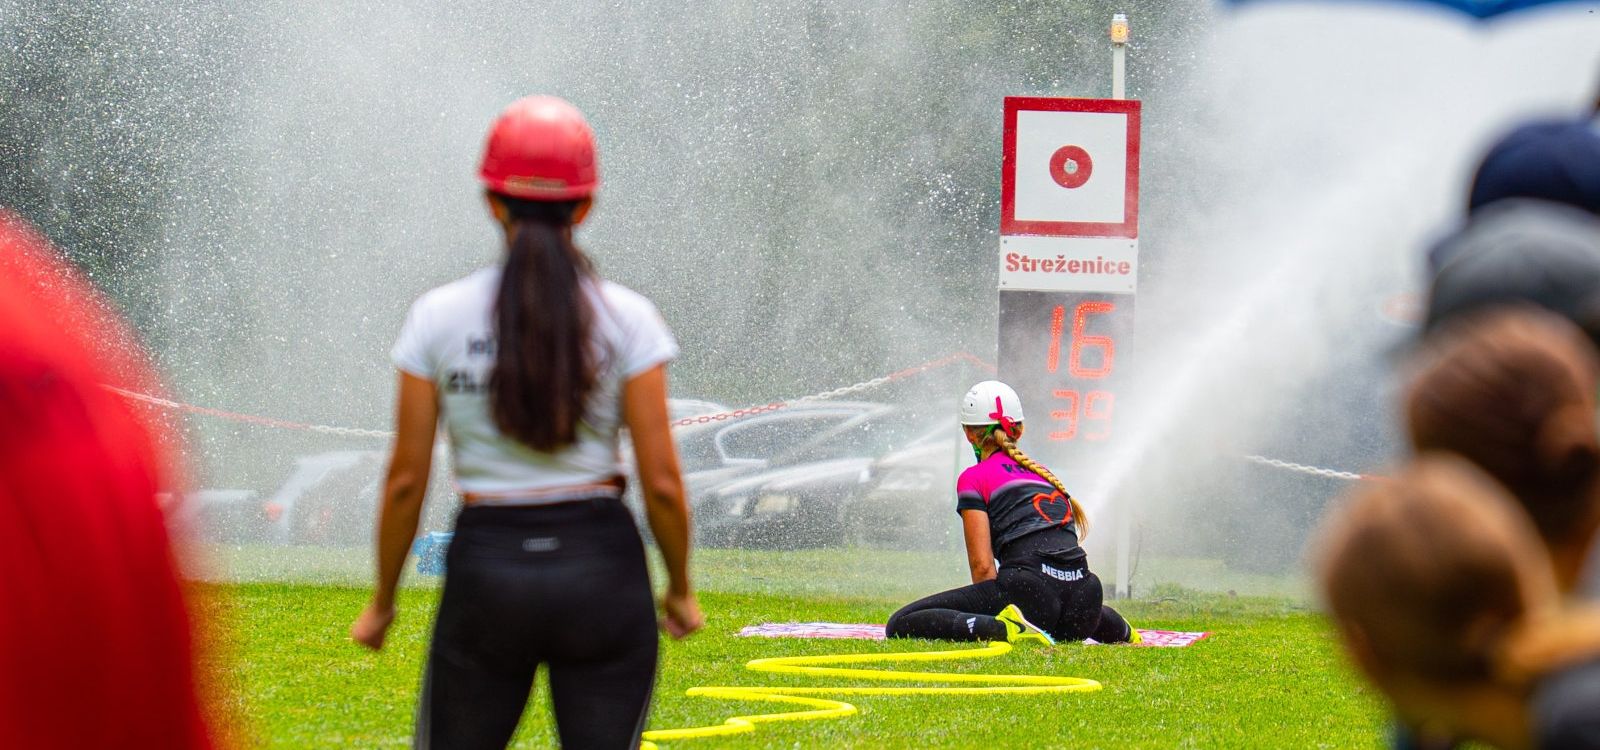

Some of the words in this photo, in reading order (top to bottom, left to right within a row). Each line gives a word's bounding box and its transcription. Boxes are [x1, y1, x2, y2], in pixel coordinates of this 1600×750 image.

[1006, 252, 1131, 275] Streženice
[1048, 301, 1116, 379] 16
[1049, 389, 1115, 441] 39
[1041, 563, 1083, 582] NEBBIA
